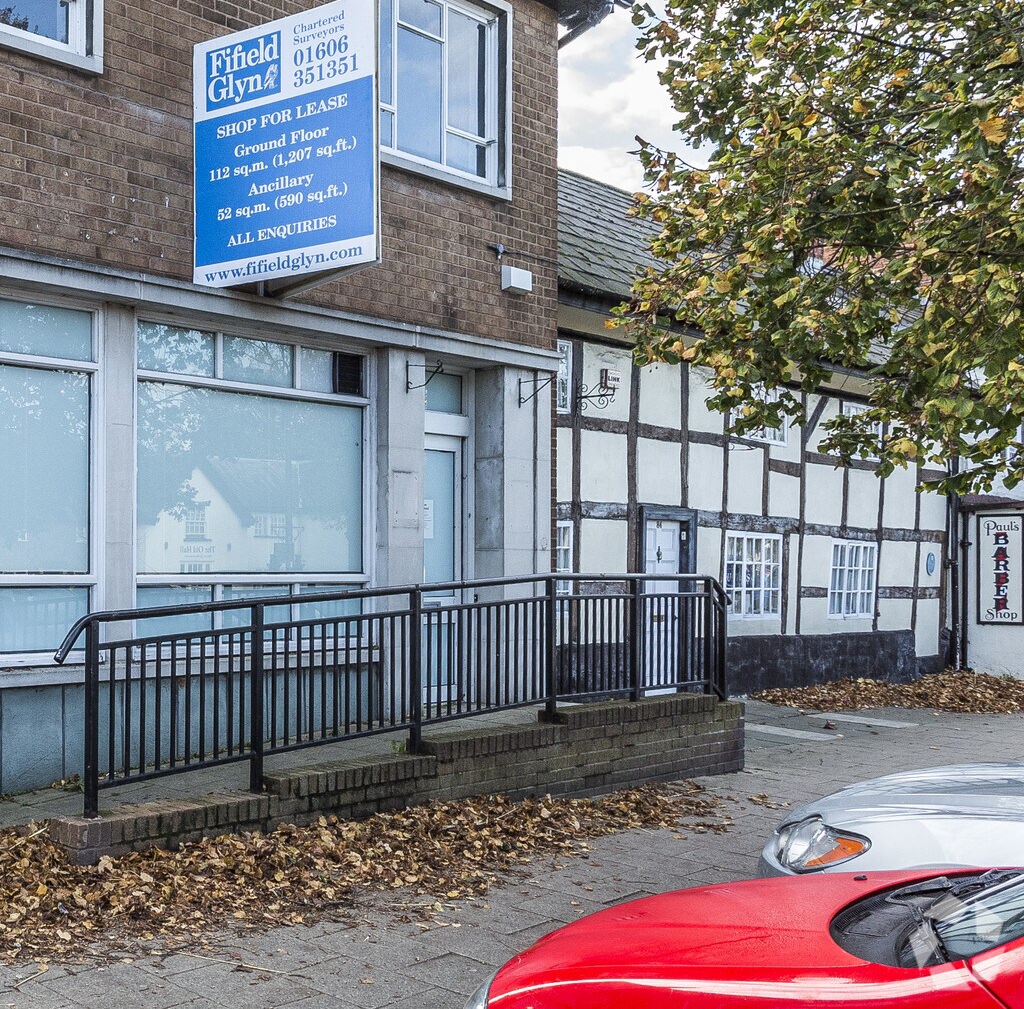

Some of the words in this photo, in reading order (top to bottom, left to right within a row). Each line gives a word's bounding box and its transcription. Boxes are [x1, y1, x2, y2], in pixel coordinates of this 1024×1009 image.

[293, 10, 345, 35] Chartered
[293, 24, 345, 46] Surveyors
[209, 33, 279, 78] Fifield
[293, 35, 349, 67] 01606
[293, 53, 359, 88] 351351
[208, 73, 263, 103] Glyn
[216, 119, 257, 139] SHOP
[260, 110, 293, 129] FOR
[296, 93, 348, 120] LEASE
[209, 166, 230, 182] 112
[234, 160, 269, 178] sq.m.
[272, 147, 312, 169] (1,207
[316, 135, 357, 158] sq.ft.)
[234, 134, 286, 158] Ground
[291, 126, 330, 145] Floor
[217, 207, 232, 221] 52
[235, 202, 270, 219] sq.m.
[274, 192, 303, 210] (590
[307, 182, 348, 204] sq.ft.)
[248, 173, 314, 197] Ancillary
[227, 229, 255, 248] ALL
[258, 214, 337, 242] ENQUIRIES
[205, 245, 363, 283] www.fifieldglyn.com
[984, 520, 1020, 537] Paul's
[991, 532, 1011, 611] BARBER
[985, 609, 1018, 621] Shop
